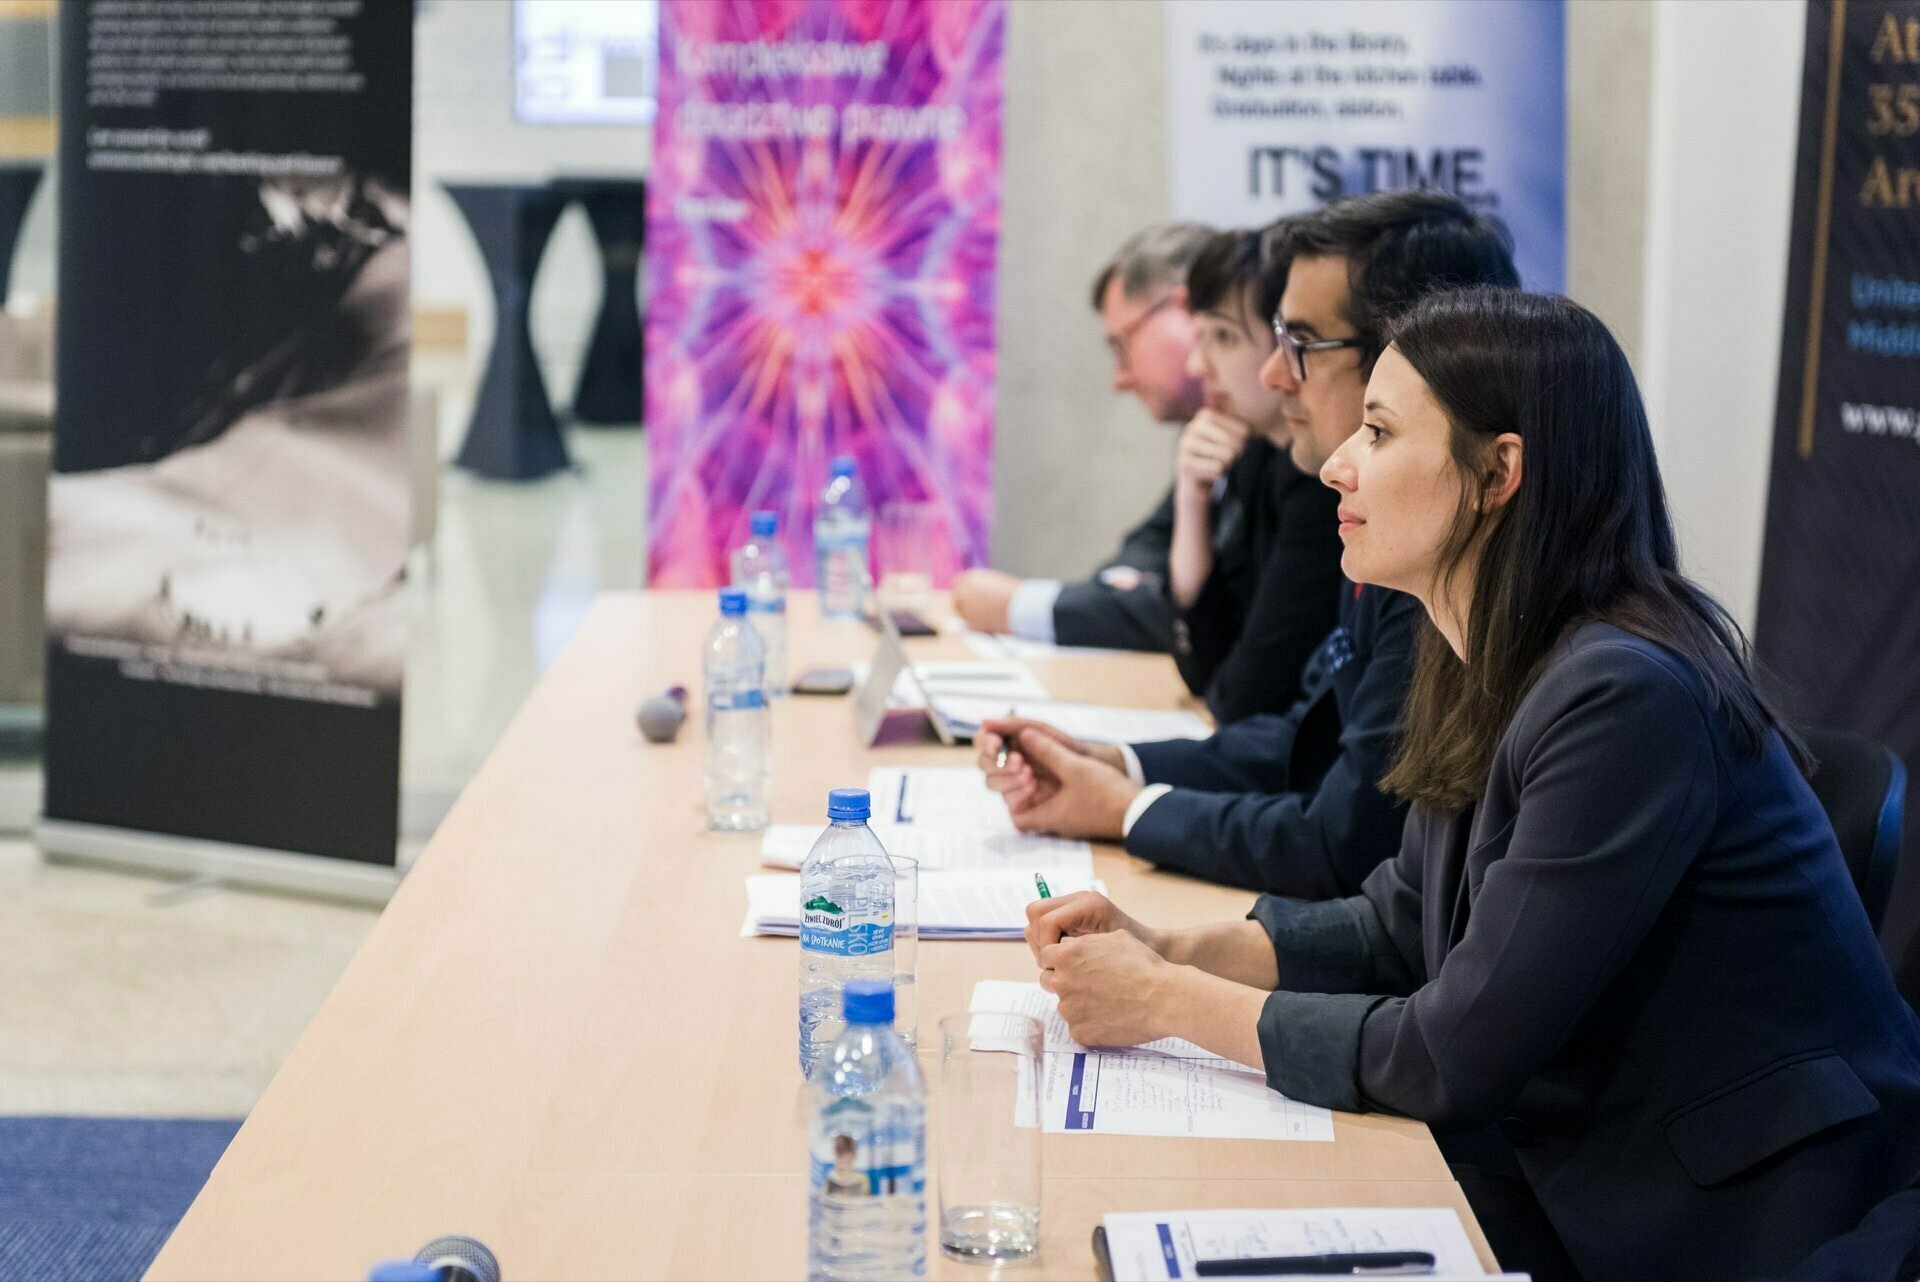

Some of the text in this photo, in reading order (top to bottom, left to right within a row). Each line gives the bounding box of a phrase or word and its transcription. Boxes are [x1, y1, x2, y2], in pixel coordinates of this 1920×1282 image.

[1247, 146, 1344, 202] IT'S
[822, 916, 843, 929] ZDRÓJ
[811, 934, 845, 949] SPOTKANIE
